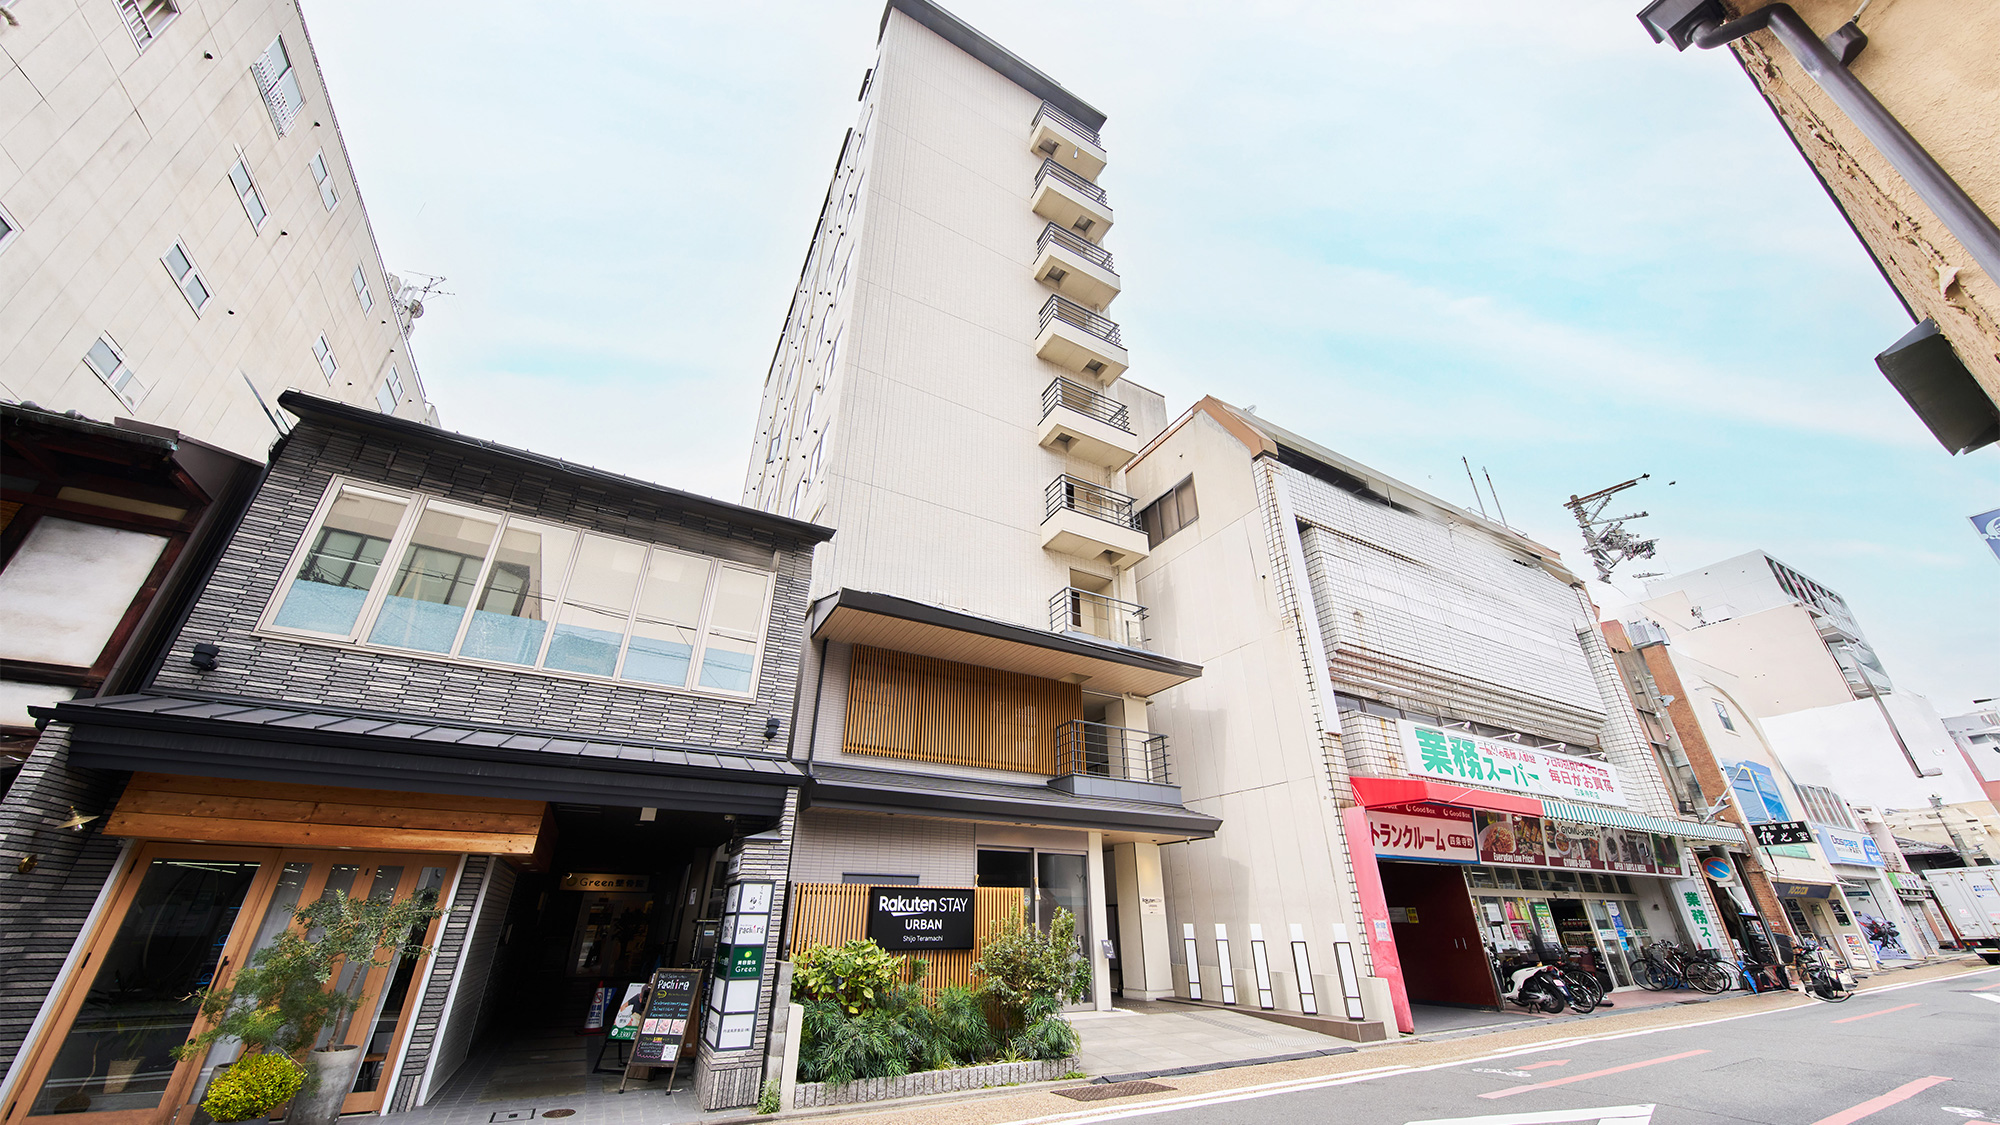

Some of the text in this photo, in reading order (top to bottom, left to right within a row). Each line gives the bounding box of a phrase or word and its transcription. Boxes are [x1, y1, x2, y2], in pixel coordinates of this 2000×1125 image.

[1414, 728, 1540, 787] 業務スーパー
[1412, 805, 1426, 813] Good
[1370, 821, 1446, 851] トランクルーム
[1449, 836, 1473, 848] 四条寺町
[1493, 852, 1514, 862] Everyday
[879, 895, 968, 913] Rakuten STAY
[905, 919, 942, 930] URBAN
[903, 935, 916, 943] Shijo
[735, 965, 756, 973] Green
